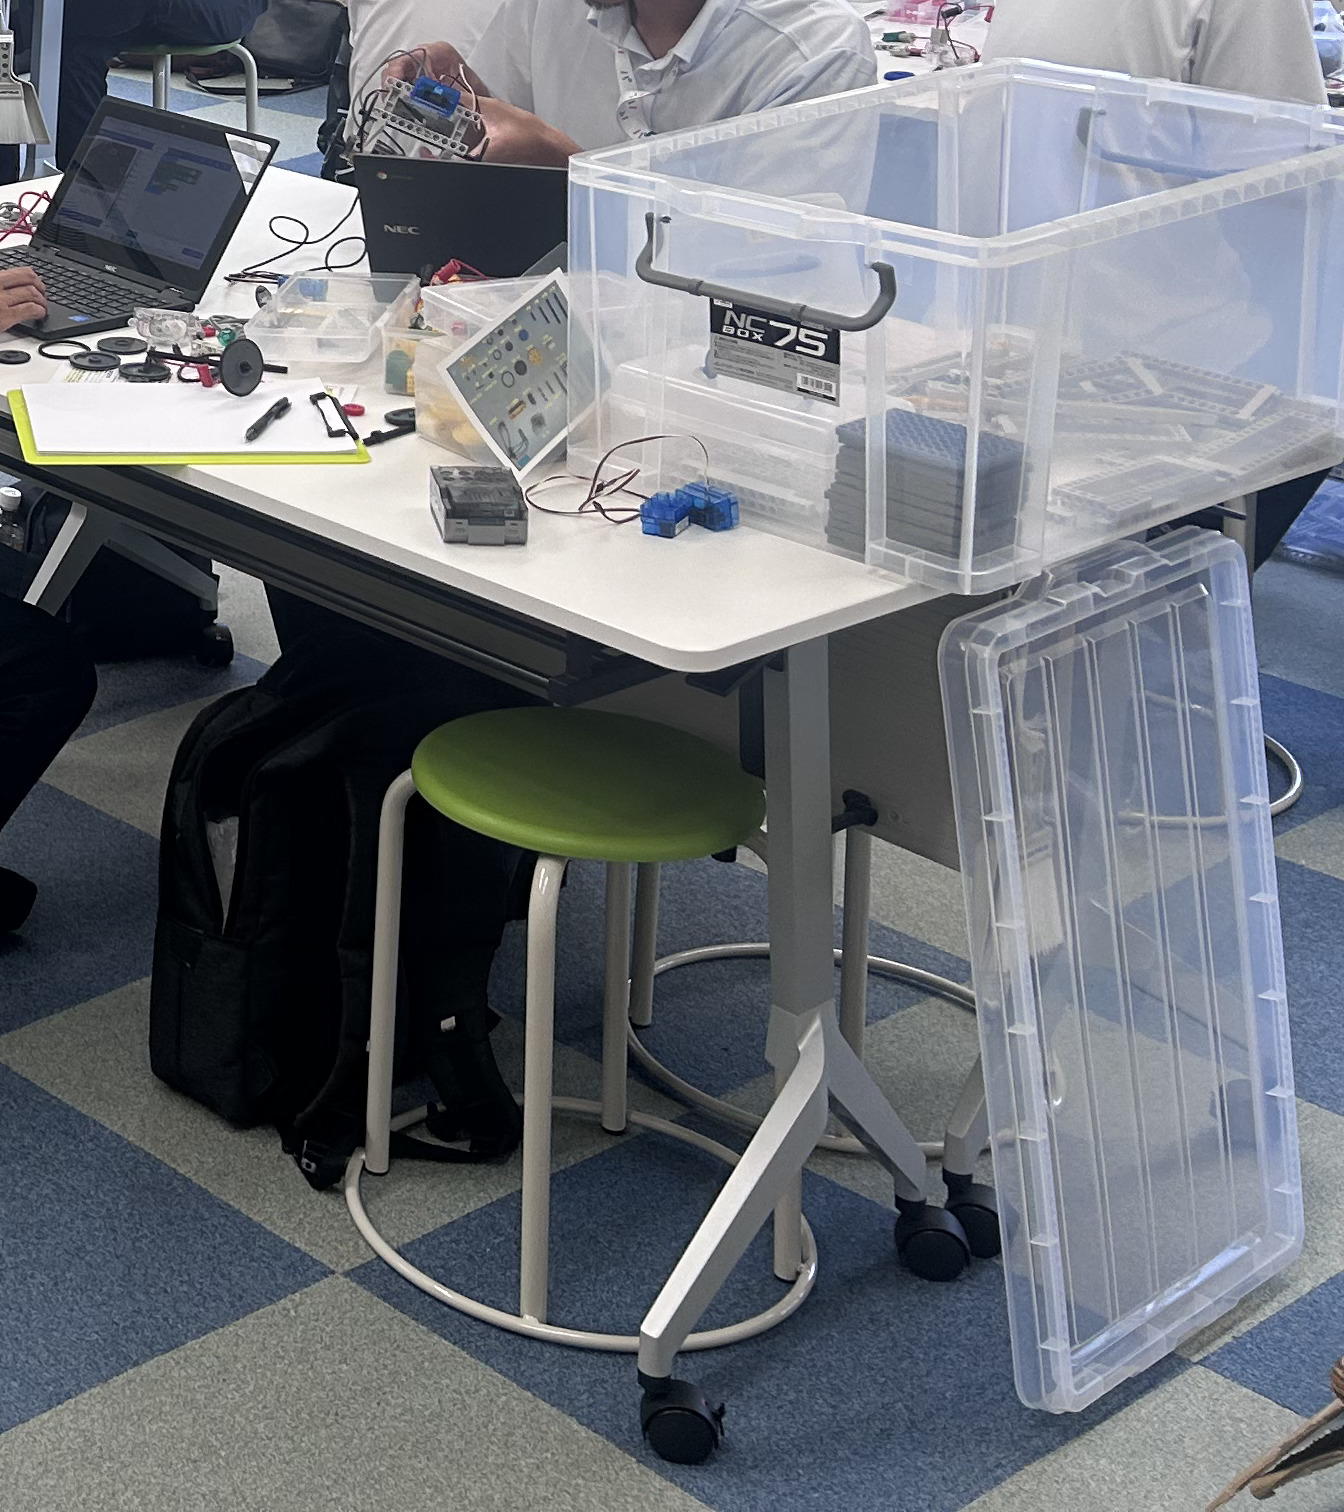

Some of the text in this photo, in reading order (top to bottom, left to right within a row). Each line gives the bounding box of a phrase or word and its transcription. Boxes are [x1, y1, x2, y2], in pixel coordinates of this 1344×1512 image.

[383, 224, 421, 236] NEC
[722, 325, 764, 342] BOX
[724, 309, 828, 357] NC 75
